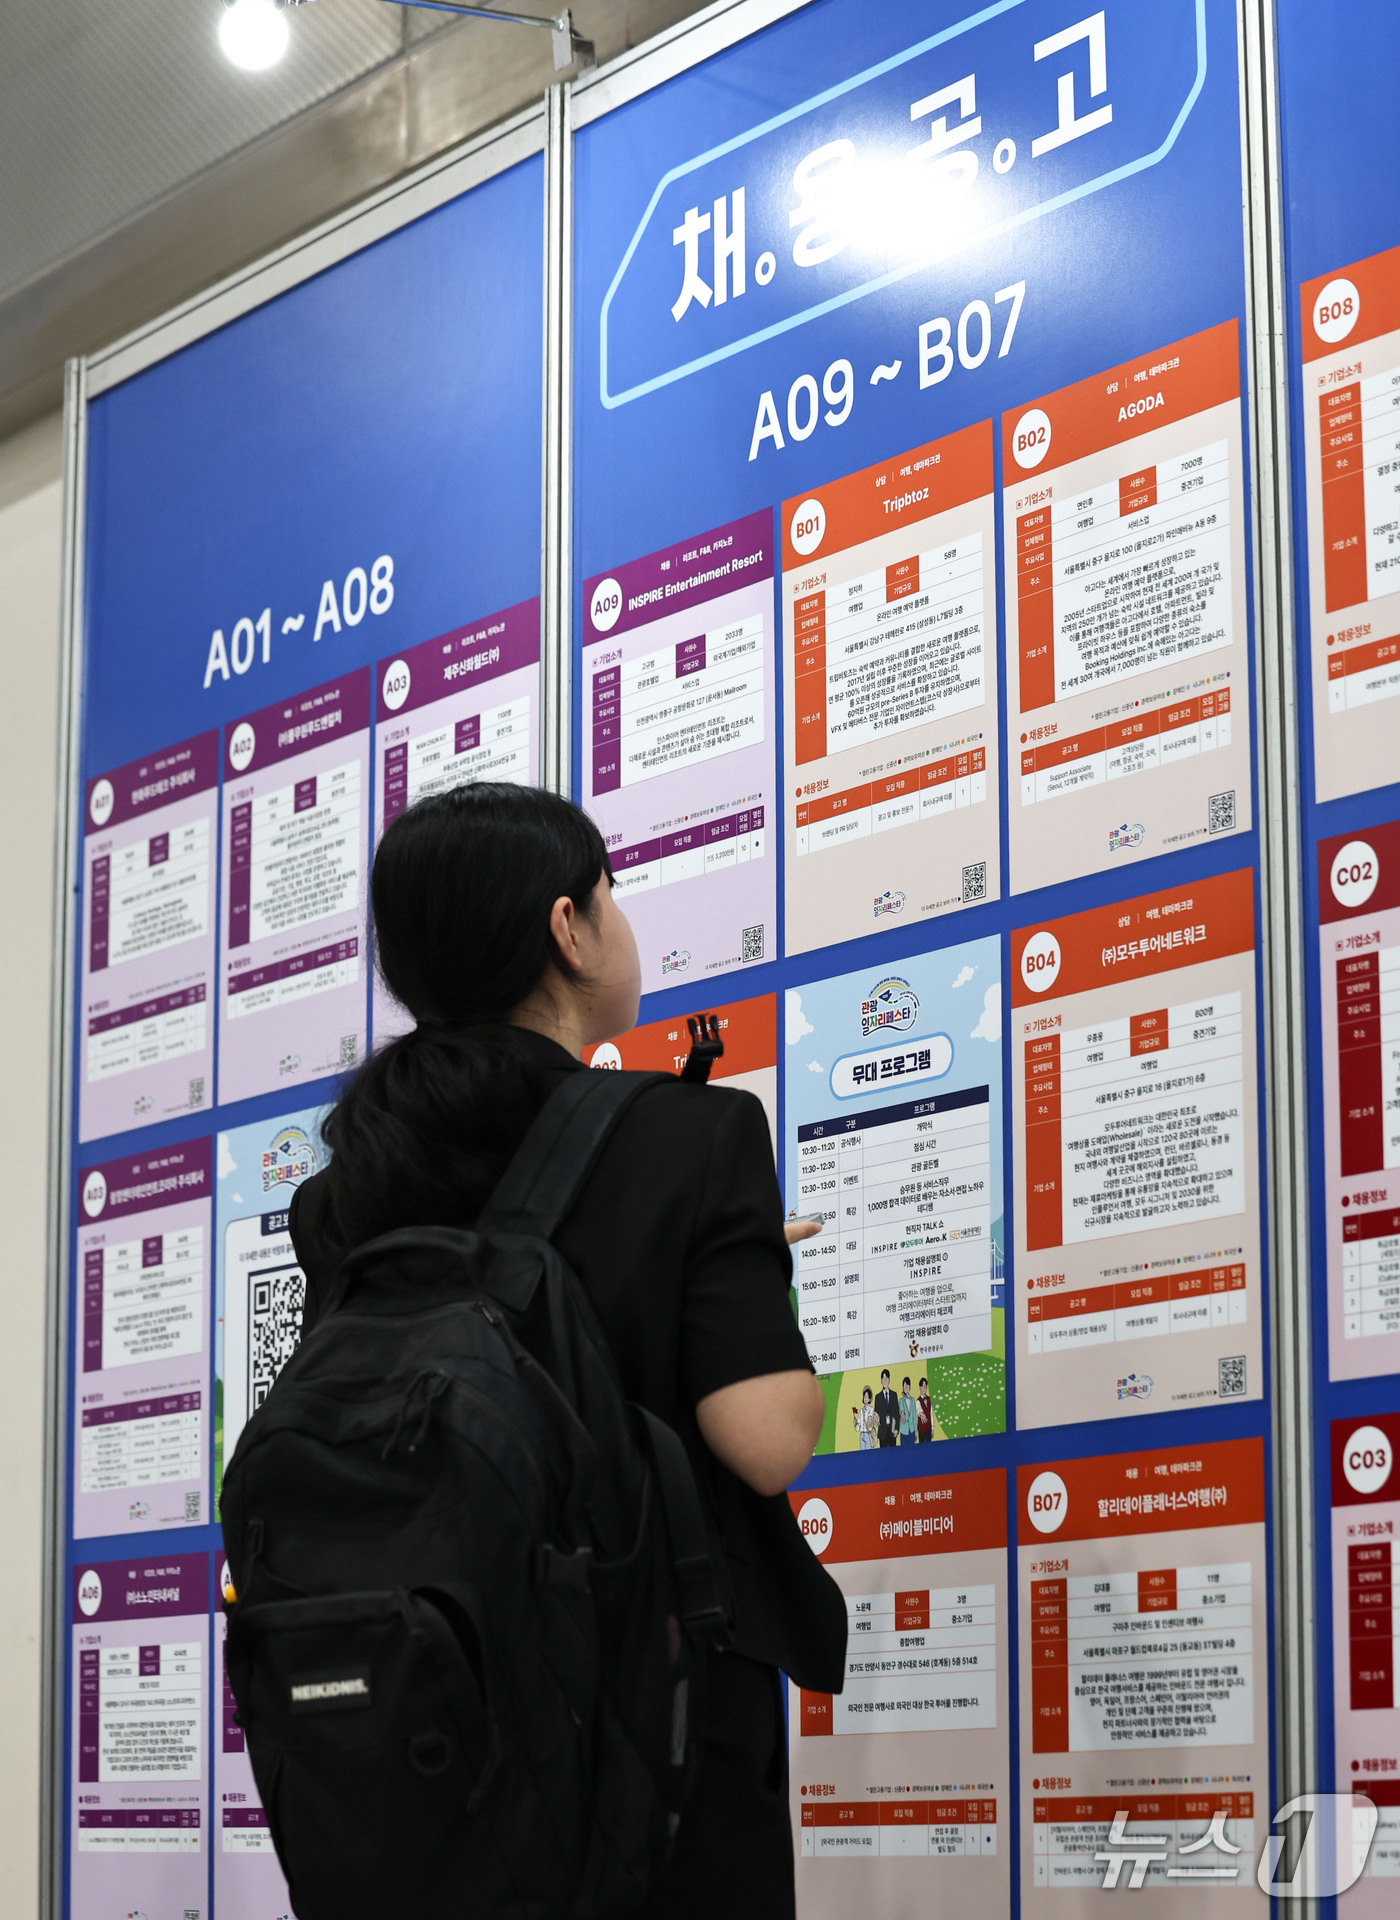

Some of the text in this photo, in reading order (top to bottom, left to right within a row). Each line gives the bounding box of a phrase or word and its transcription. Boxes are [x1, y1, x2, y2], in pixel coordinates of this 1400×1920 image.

[1319, 297, 1353, 325] B08
[747, 358, 856, 464] A09
[918, 280, 1028, 392] B07
[1106, 382, 1118, 394] 상담
[1149, 357, 1180, 376] 테마파크관
[1328, 362, 1362, 383] 기업소개
[1118, 392, 1164, 422] AGODA
[1328, 392, 1352, 406] 대표자명
[1017, 426, 1046, 451] B02
[1329, 432, 1353, 446] 주요사업
[875, 475, 886, 487] 상담
[913, 453, 941, 471] 테마파크관
[1130, 456, 1202, 488] 사원수 7000명
[1336, 459, 1348, 468] 주소
[883, 487, 929, 514] Tripbtoz
[1024, 487, 1052, 506] 기업소개
[1128, 476, 1204, 508] 기업규모 중견기업
[796, 516, 820, 538] B01
[1127, 515, 1150, 529] 서비스업
[1333, 536, 1358, 550] 기업 소개
[896, 549, 957, 575] 사원수 58명
[594, 550, 763, 616] A09 INSPIRE Entertainment Resort
[801, 572, 827, 591] 기업소개
[877, 596, 929, 622] 온라인 여행 예약 플랫폼
[203, 607, 271, 689] A01
[313, 554, 394, 642] A08
[845, 605, 963, 654] 서울특별시 강남구 테헤란로 415 (삼성동) L7빌딩 3층
[1337, 624, 1371, 643] 채용정보
[599, 649, 622, 664] 기업소개
[682, 660, 699, 671] 기업규모
[386, 676, 407, 695] A03
[1029, 723, 1058, 741] 채용정보
[1049, 763, 1092, 782] Support Associate
[803, 778, 829, 796] 채용정보
[1336, 862, 1373, 886] C02
[1118, 916, 1131, 928] 상담
[1162, 899, 1193, 916] 테마파크관
[1346, 931, 1381, 950] 기업소개
[1026, 951, 1056, 973] B04
[861, 999, 878, 1014] 관광
[861, 1007, 910, 1036] 일자리페스타
[1033, 1014, 1062, 1031] 기업소개
[667, 1031, 678, 1041] 채용
[1139, 1026, 1216, 1049] 기업규모 중견기업
[1354, 1030, 1365, 1039] 주소
[853, 1049, 931, 1085] 무대 프로그램
[1141, 1059, 1158, 1071] 여행업
[813, 1102, 936, 1135] 시간 구분 프로그램
[841, 1136, 861, 1148] 공식행사
[917, 1120, 933, 1131] 개막식
[914, 1142, 924, 1152] 점심
[926, 1139, 936, 1149] 시간
[262, 1152, 278, 1167] 관광
[262, 1161, 308, 1192] 일자리페스타
[844, 1175, 859, 1186] 이벤트
[911, 1162, 922, 1172] 관광
[923, 1159, 939, 1170] 골든벨
[900, 1177, 949, 1195] 승무원 등 서비스직무
[846, 1207, 857, 1216] 특강
[867, 1202, 888, 1213] 1,000명
[889, 1198, 899, 1208] 합격
[900, 1194, 921, 1207] 데이터로
[922, 1192, 937, 1202] 배우는
[968, 1181, 984, 1192] 노하우
[1352, 1190, 1388, 1206] 채용정보
[917, 1203, 933, 1213] 테디쌤
[268, 1215, 283, 1230] 공고
[905, 1224, 922, 1235] 현직자
[923, 1223, 937, 1231] TALK
[846, 1241, 857, 1250] 대담
[872, 1243, 898, 1254] INSPIRE
[905, 1236, 923, 1247] 모두투어
[903, 1256, 914, 1267] 기업
[915, 1253, 941, 1265] 채용설명회
[844, 1274, 859, 1284] 설명회
[910, 1266, 941, 1278] INSPIRE
[1036, 1274, 1066, 1289] 채용정보
[898, 1284, 954, 1301] 좋아하는 여행을 업으로,
[886, 1292, 967, 1313] 여행 크리에이터부터 스타트업까지
[846, 1311, 857, 1320] 특강
[899, 1309, 936, 1322] 여행크리에이터
[937, 1306, 953, 1316] 채코제
[904, 1329, 914, 1339] 기업
[915, 1326, 942, 1337] 채용설명회
[844, 1344, 943, 1359] 설명회 한국관광공사
[1349, 1449, 1386, 1470] C03
[1033, 1493, 1062, 1512] B07
[801, 1517, 828, 1535] B06
[1358, 1521, 1393, 1535] 기업소개
[1039, 1559, 1069, 1573] 기업소개
[809, 1784, 836, 1796] 채용정보
[1042, 1777, 1072, 1791] 채용정보
